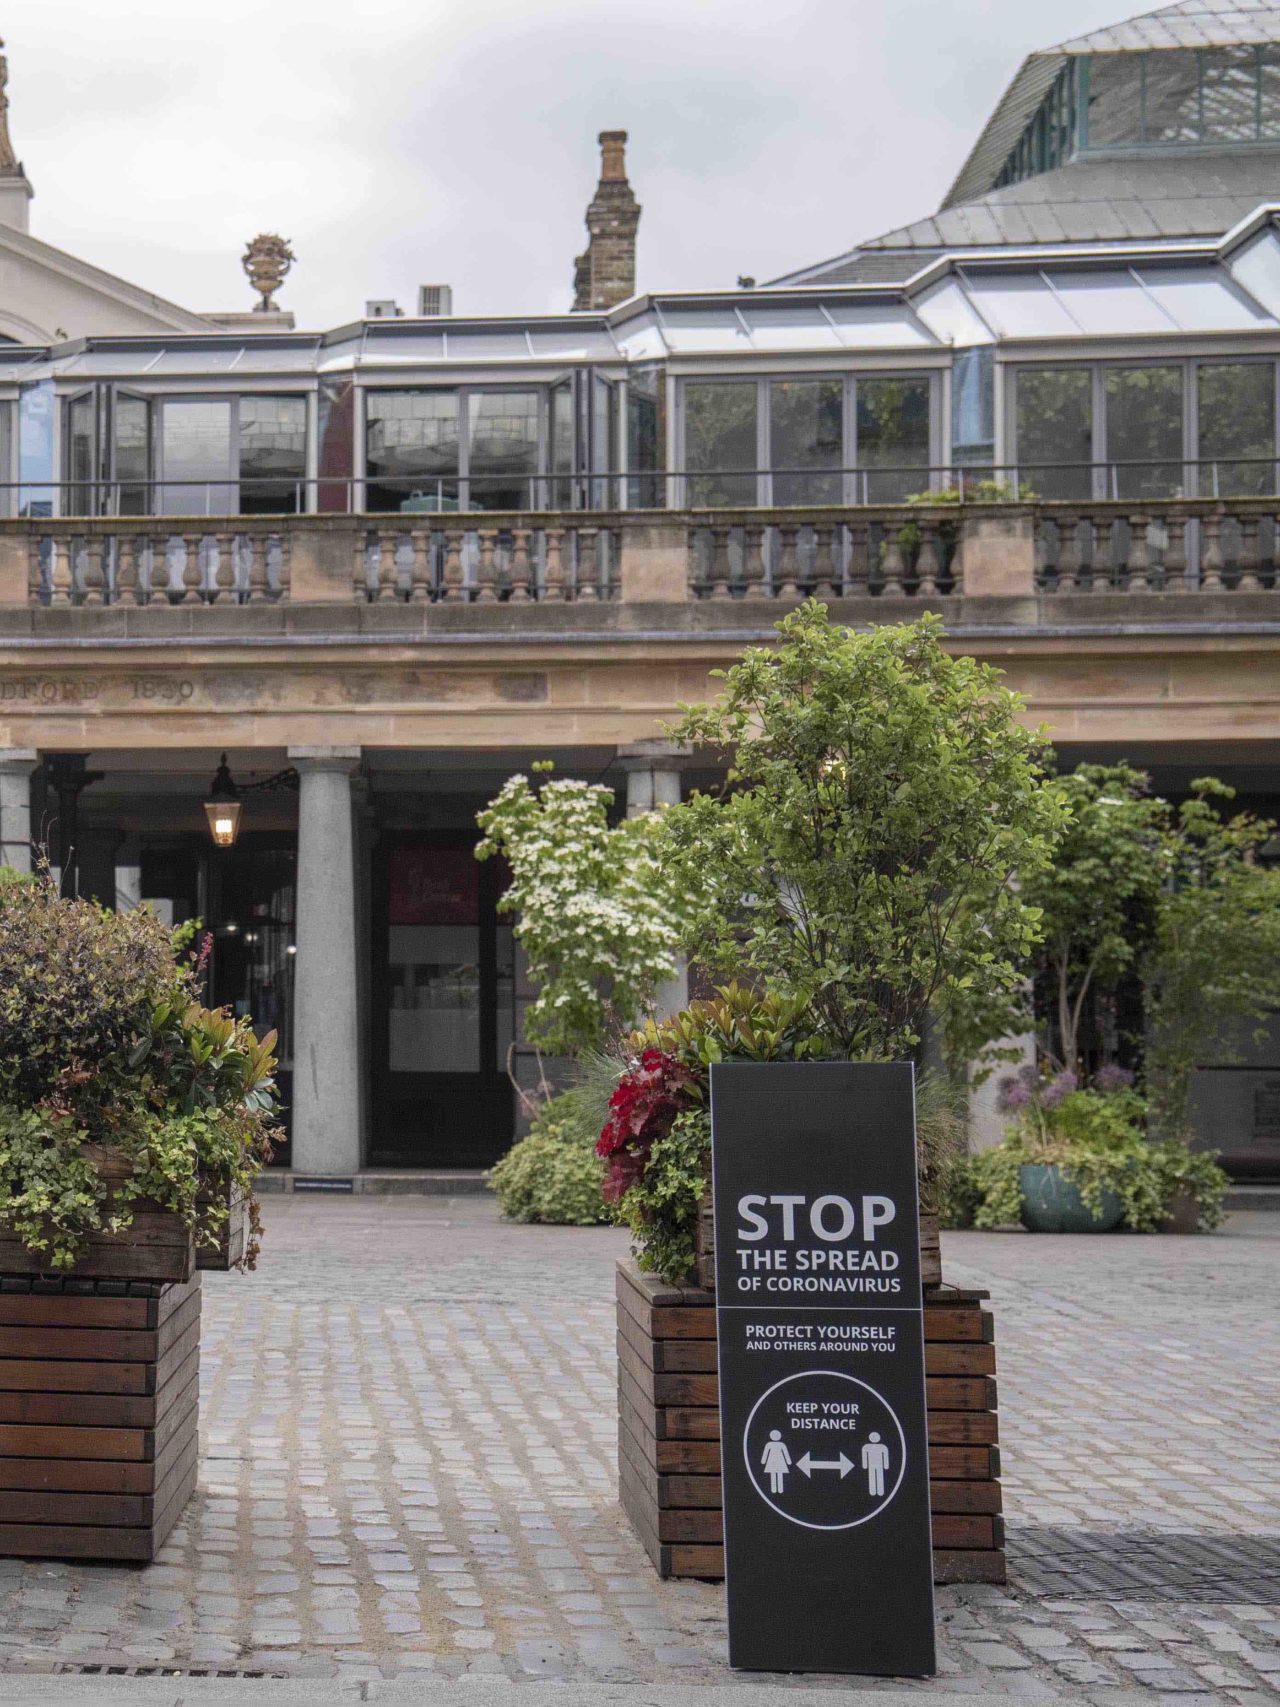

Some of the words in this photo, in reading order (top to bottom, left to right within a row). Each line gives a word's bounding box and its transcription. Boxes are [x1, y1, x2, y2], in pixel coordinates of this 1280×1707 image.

[131, 680, 195, 701] 1830
[738, 1195, 895, 1241] STOP
[736, 1250, 787, 1270] THE
[796, 1250, 898, 1270] SPREAD
[738, 1277, 761, 1290] OF
[767, 1277, 900, 1292] CORONAVIRUS
[746, 1325, 813, 1337] PROTECT
[817, 1326, 895, 1338] YOURSELF
[747, 1341, 770, 1350] AND
[774, 1342, 816, 1350] OTHERS
[819, 1342, 868, 1351] AROUND
[871, 1343, 895, 1351] YOU
[787, 1403, 818, 1413] KEEP
[822, 1403, 859, 1414] YOUR
[792, 1418, 855, 1429] DISTANCE
